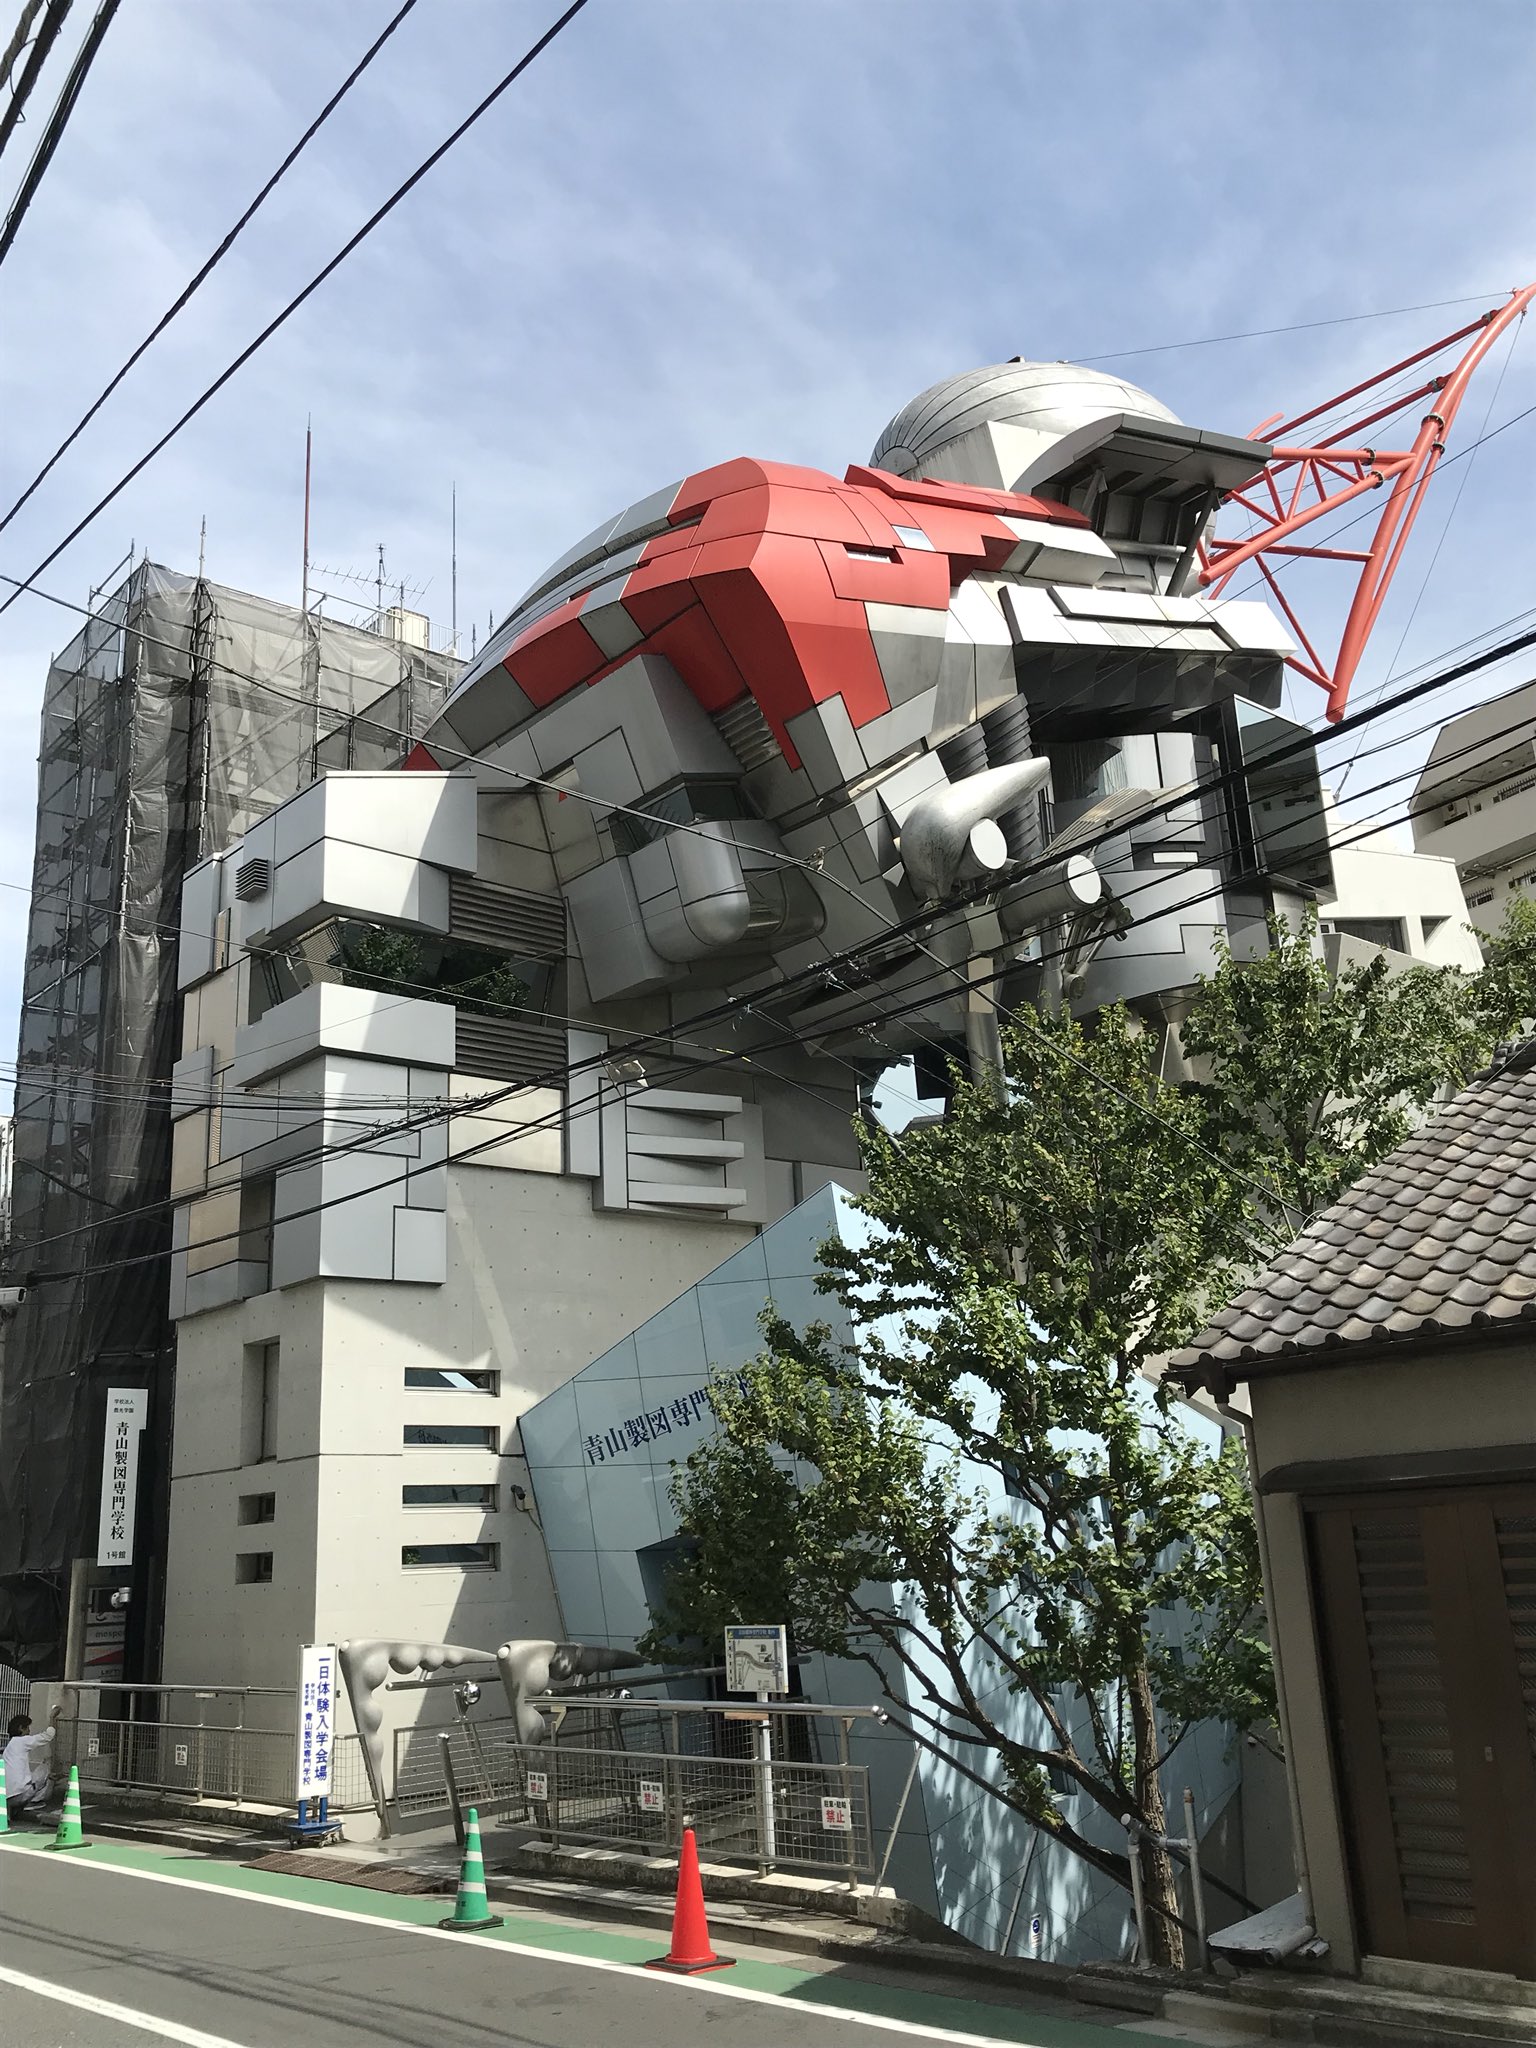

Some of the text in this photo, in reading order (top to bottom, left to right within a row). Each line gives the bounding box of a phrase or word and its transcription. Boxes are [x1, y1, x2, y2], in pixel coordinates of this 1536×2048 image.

[582, 1373, 749, 1465] 青山製図専門
[110, 1421, 130, 1540] 青山製図専門学校
[106, 1550, 126, 1560] 1号館
[314, 1657, 331, 1781] 一日体験入学会場
[644, 1792, 659, 1805] 禁止
[826, 1809, 846, 1824] 禁止
